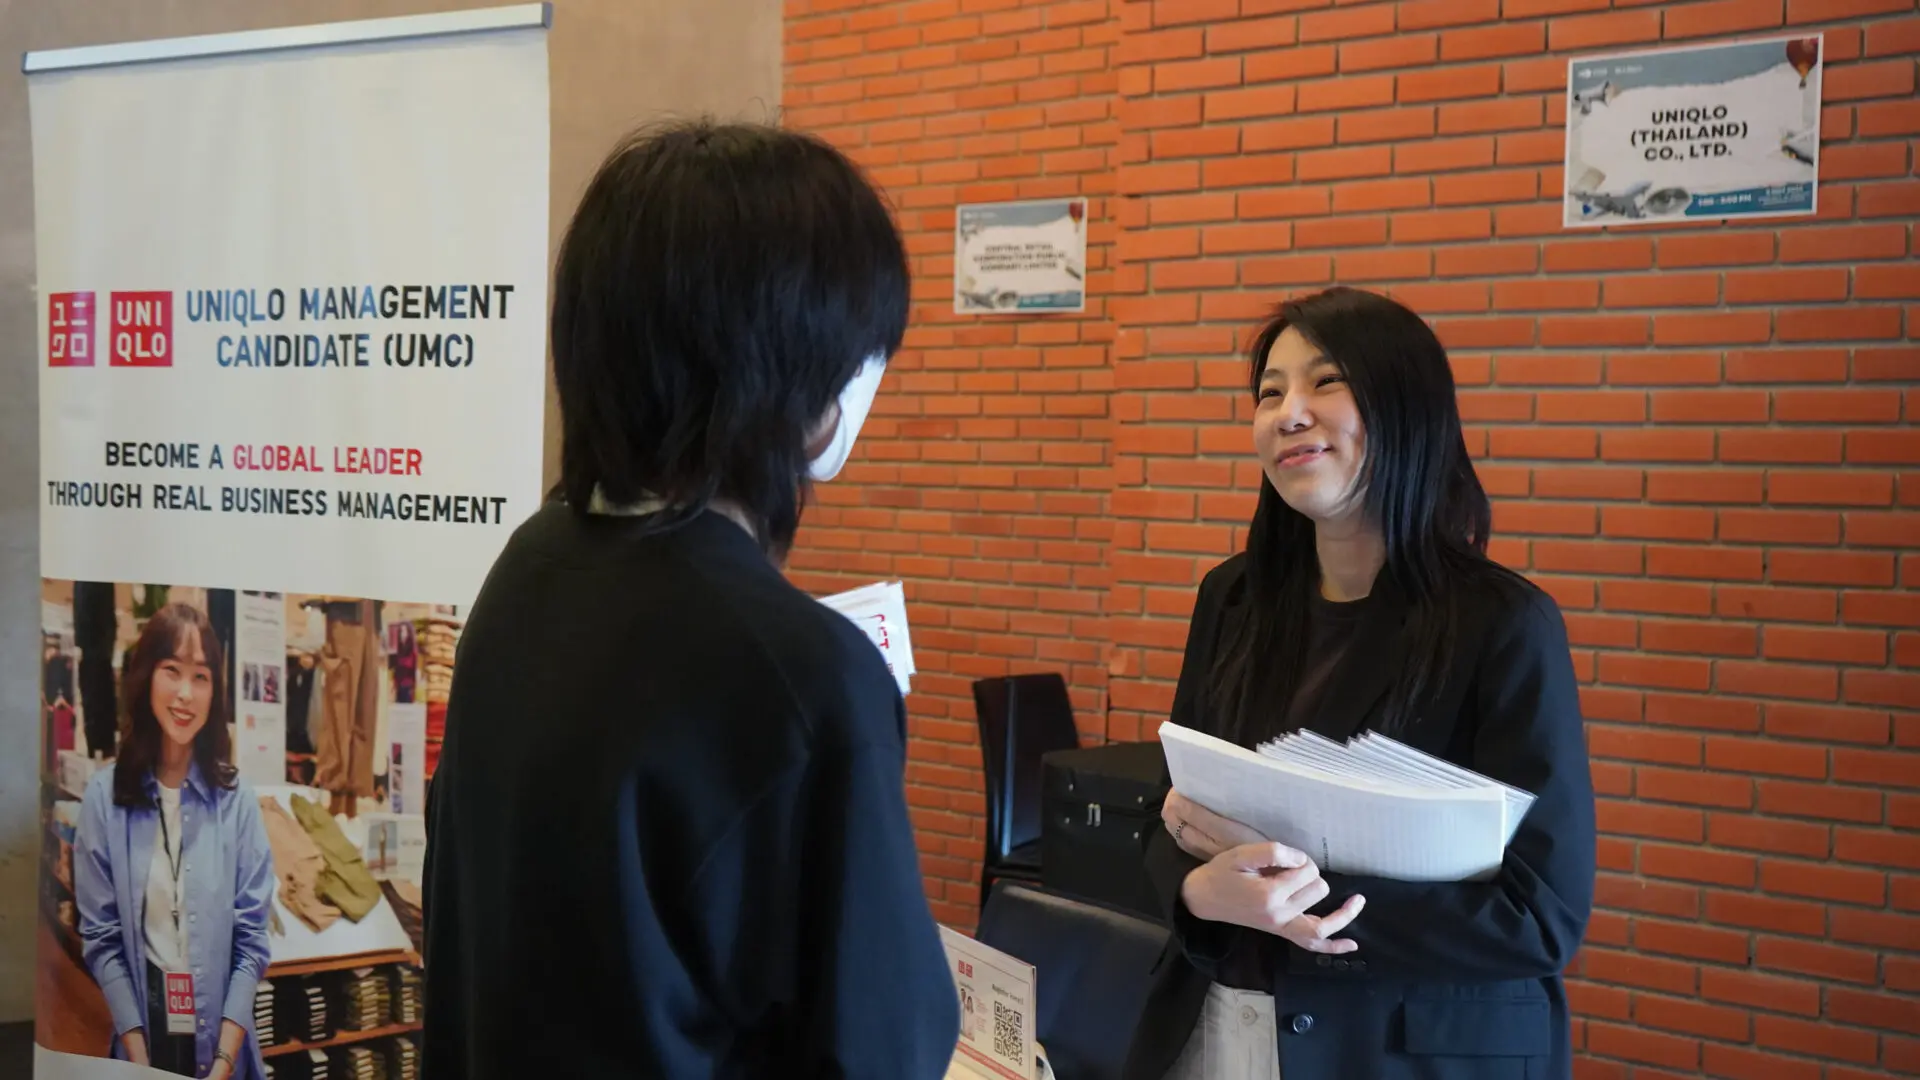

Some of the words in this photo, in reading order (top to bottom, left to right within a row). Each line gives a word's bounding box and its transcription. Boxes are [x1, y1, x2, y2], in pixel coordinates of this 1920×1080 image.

[1651, 105, 1728, 122] UNIQLO
[1631, 121, 1748, 147] (THAILAND)
[1644, 145, 1684, 162] CO.,
[1689, 142, 1733, 159] LTD.
[116, 300, 163, 327] UNI
[186, 288, 286, 325] UNIQLO
[299, 285, 515, 320] MANAGEMENT
[116, 331, 167, 363] QLO
[216, 333, 370, 368] CANDIDATE
[383, 333, 474, 368] (UMC)
[105, 441, 200, 469] BECOME
[208, 444, 225, 470] A
[233, 445, 325, 473] GLOBAL
[334, 447, 423, 476] LEADER
[47, 481, 142, 509] THROUGH
[153, 484, 212, 512] REAL
[221, 487, 328, 517] BUSINESS
[338, 491, 508, 525] MANAGEMENT
[170, 979, 190, 993] UNI
[170, 995, 192, 1012] QLO
